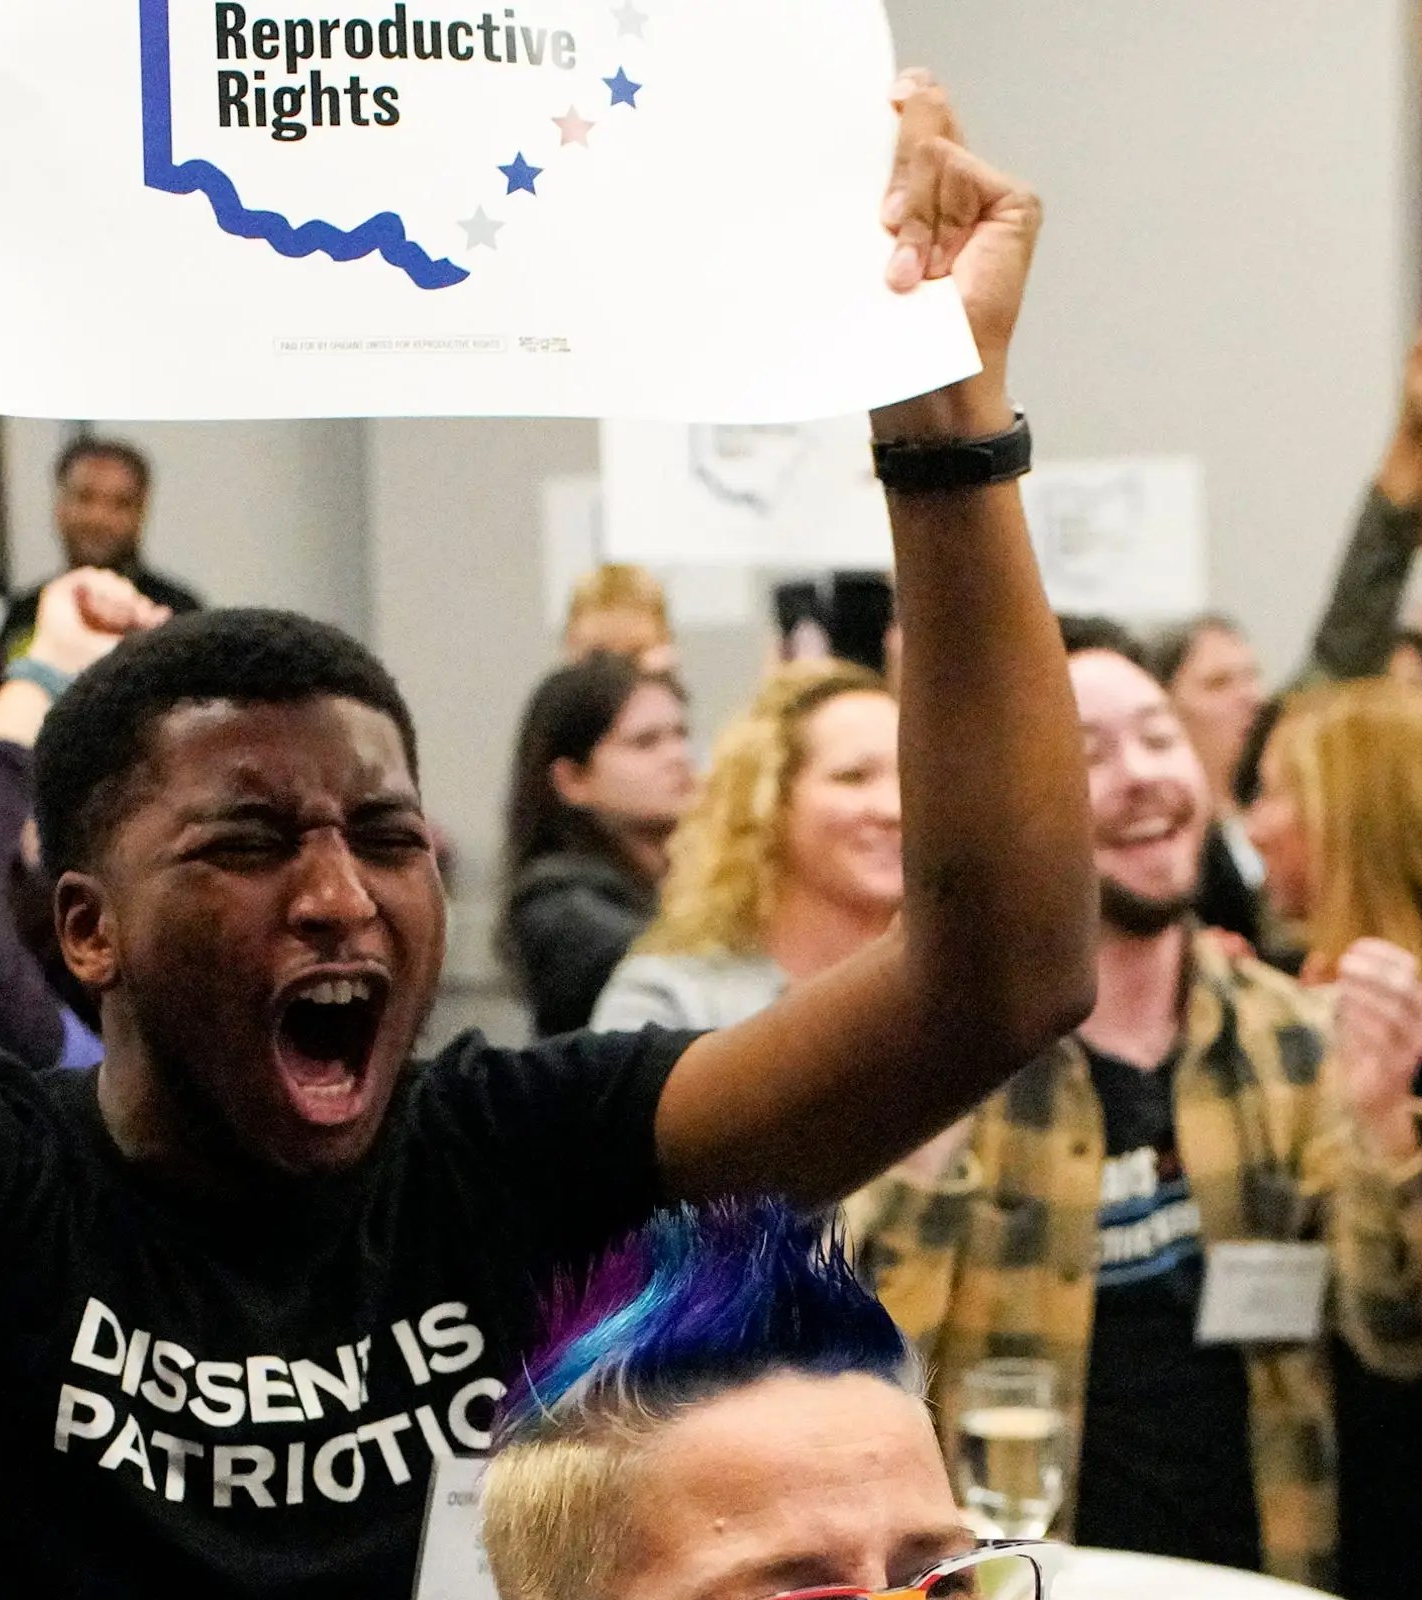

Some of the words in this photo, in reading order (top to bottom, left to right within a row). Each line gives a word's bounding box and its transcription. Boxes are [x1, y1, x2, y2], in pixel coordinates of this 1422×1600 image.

[216, 2, 577, 72] Reproductive
[218, 70, 401, 141] Rights
[392, 1301, 485, 1386] IS
[53, 1377, 507, 1508] PATRIOTIC
